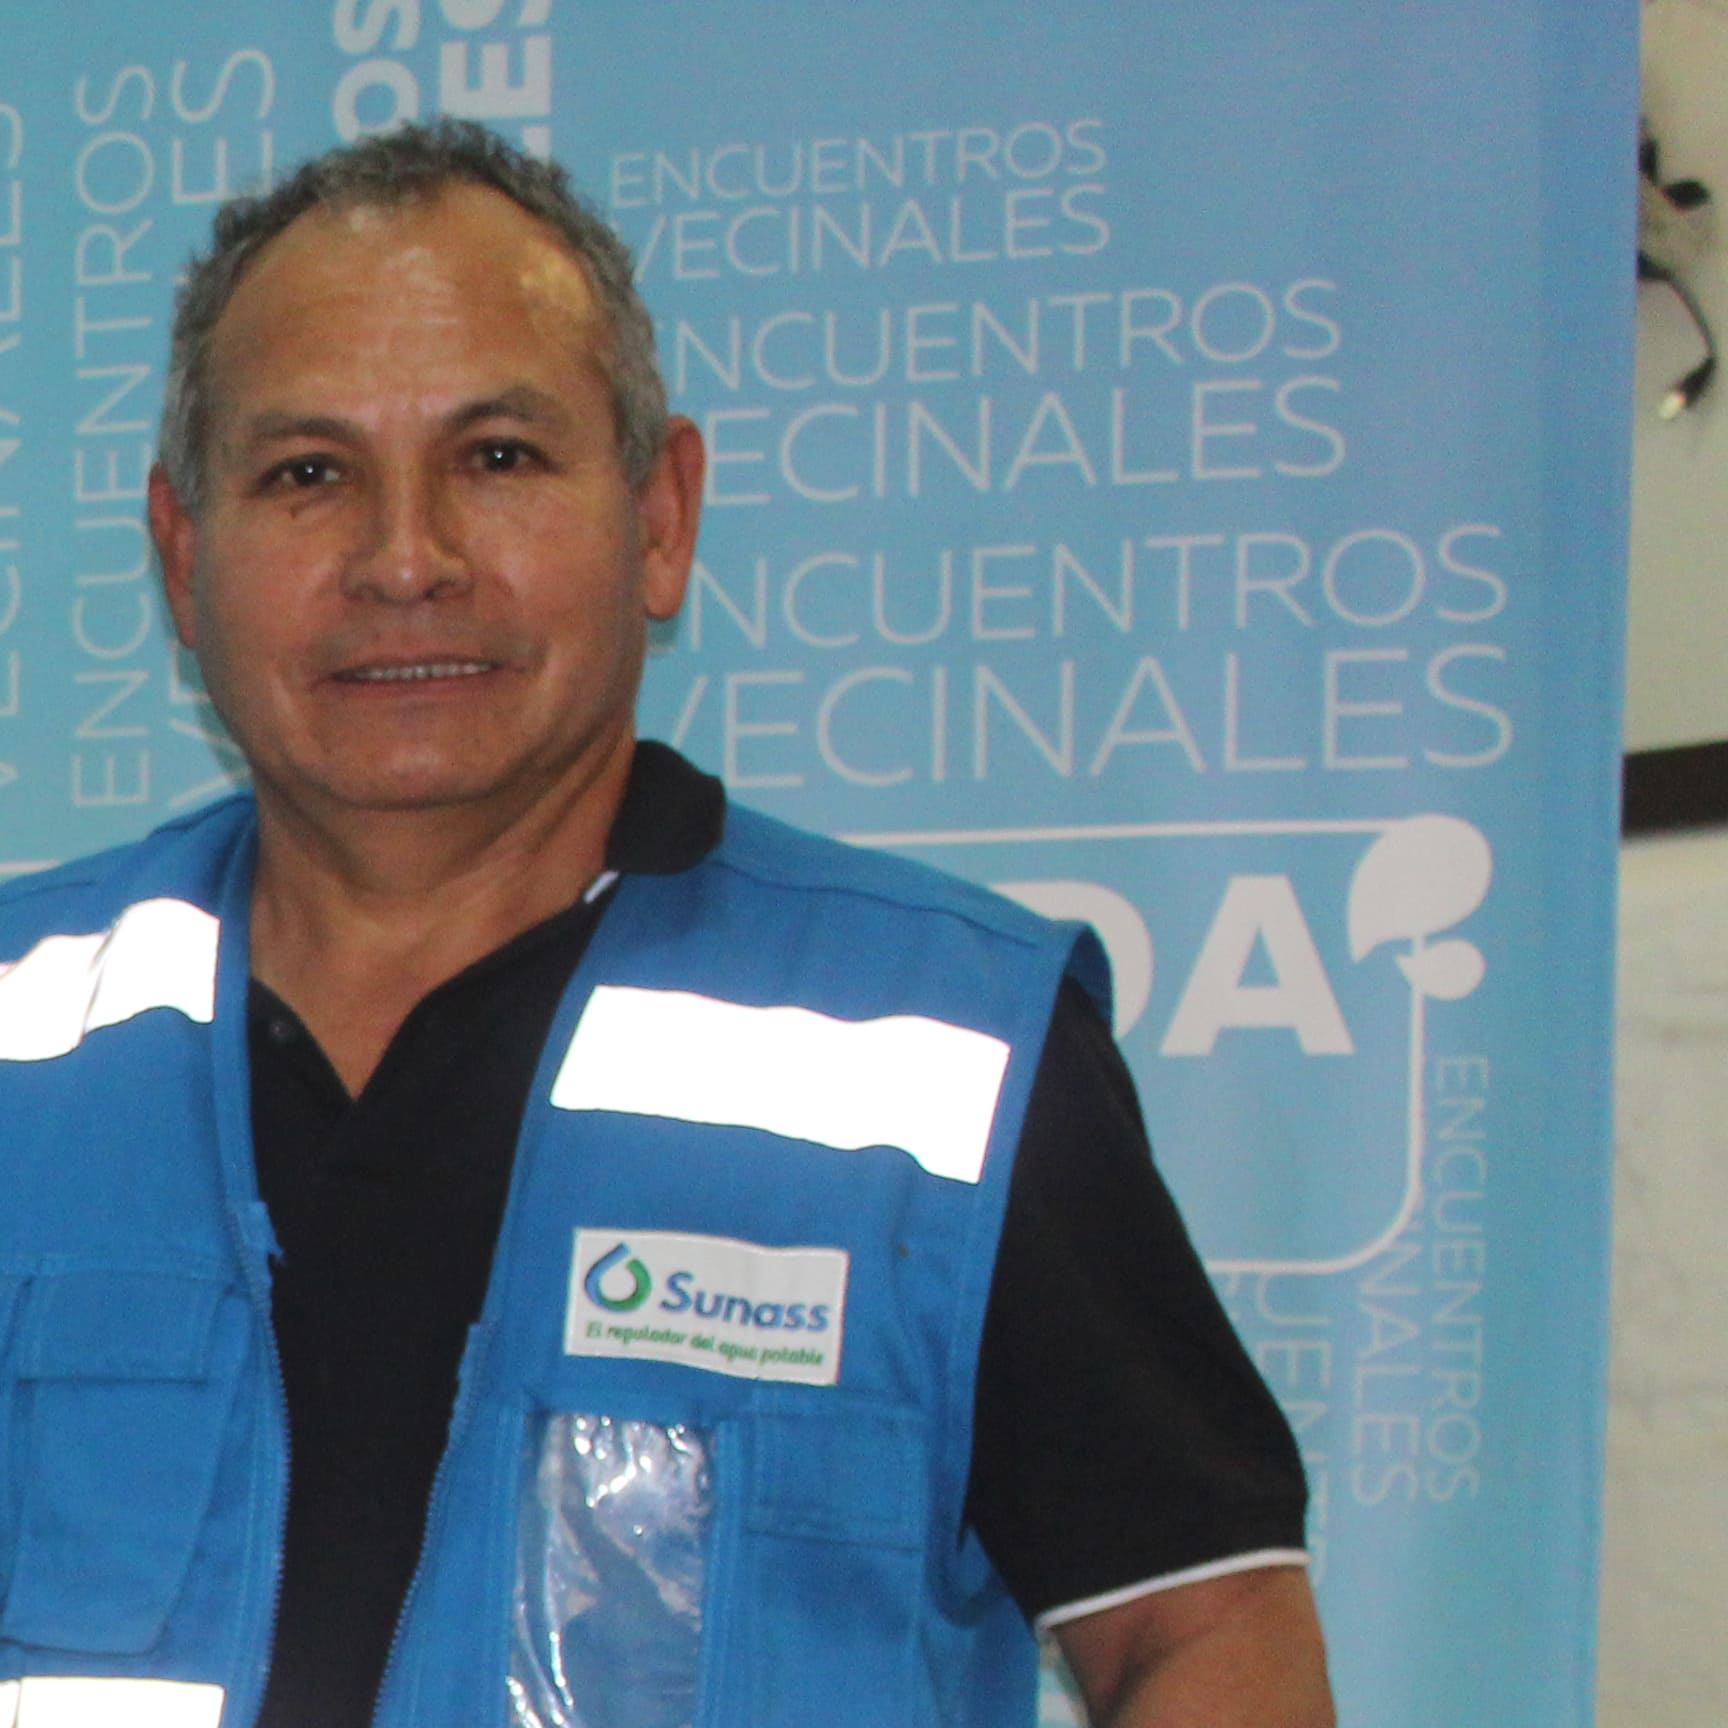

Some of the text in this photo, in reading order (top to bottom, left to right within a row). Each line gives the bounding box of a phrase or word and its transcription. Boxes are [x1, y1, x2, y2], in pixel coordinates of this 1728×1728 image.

[611, 118, 1107, 209] ENCUENTROS
[672, 279, 1341, 394] NCUENTROS
[72, 65, 156, 809] ENCUENTROS
[705, 376, 1346, 505] ECINALES
[686, 523, 1506, 652] NCUENTROS
[660, 1269, 830, 1332] Sunass
[1427, 1054, 1491, 1503] ENCUENTROS
[606, 1324, 688, 1347] regulador
[690, 1332, 716, 1353] del
[718, 1341, 758, 1362] agua
[759, 1345, 824, 1367] potable
